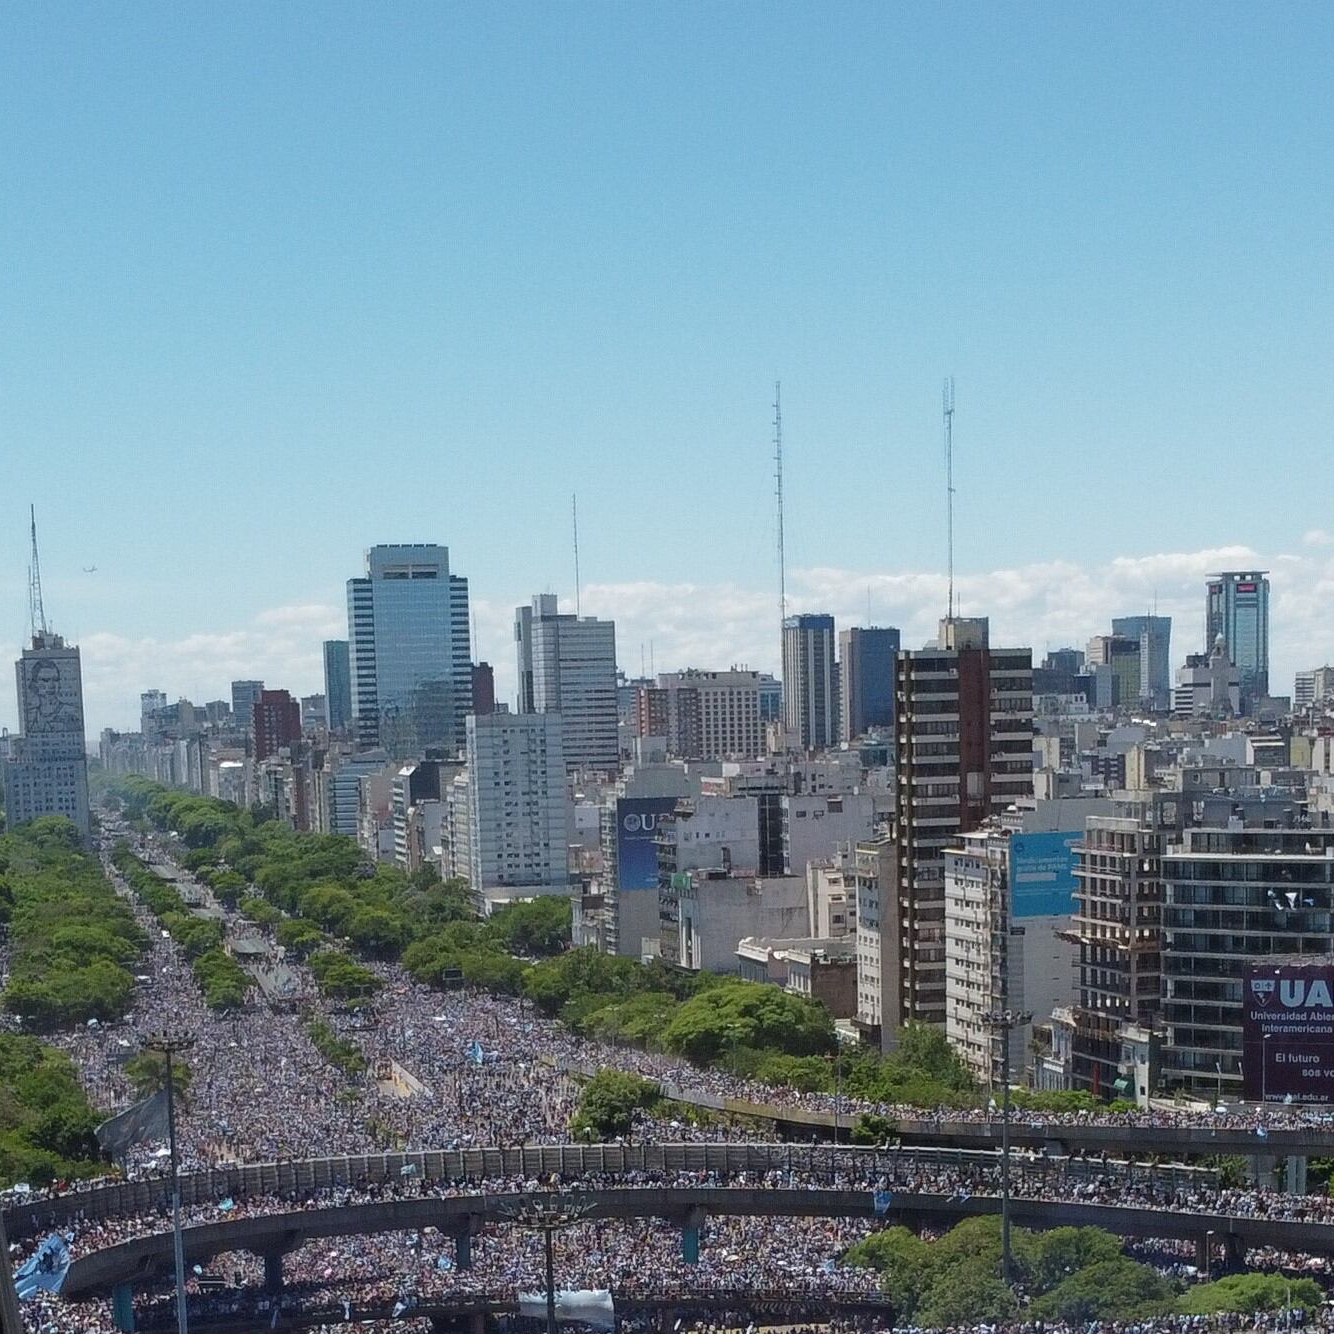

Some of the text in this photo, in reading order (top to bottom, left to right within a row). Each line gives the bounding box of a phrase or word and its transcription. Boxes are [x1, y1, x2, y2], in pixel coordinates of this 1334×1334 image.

[1250, 1011, 1307, 1021] Universidad
[1261, 1024, 1333, 1033] Interamericana
[1275, 1053, 1320, 1063] El futuro
[1302, 1069, 1321, 1077] sos
